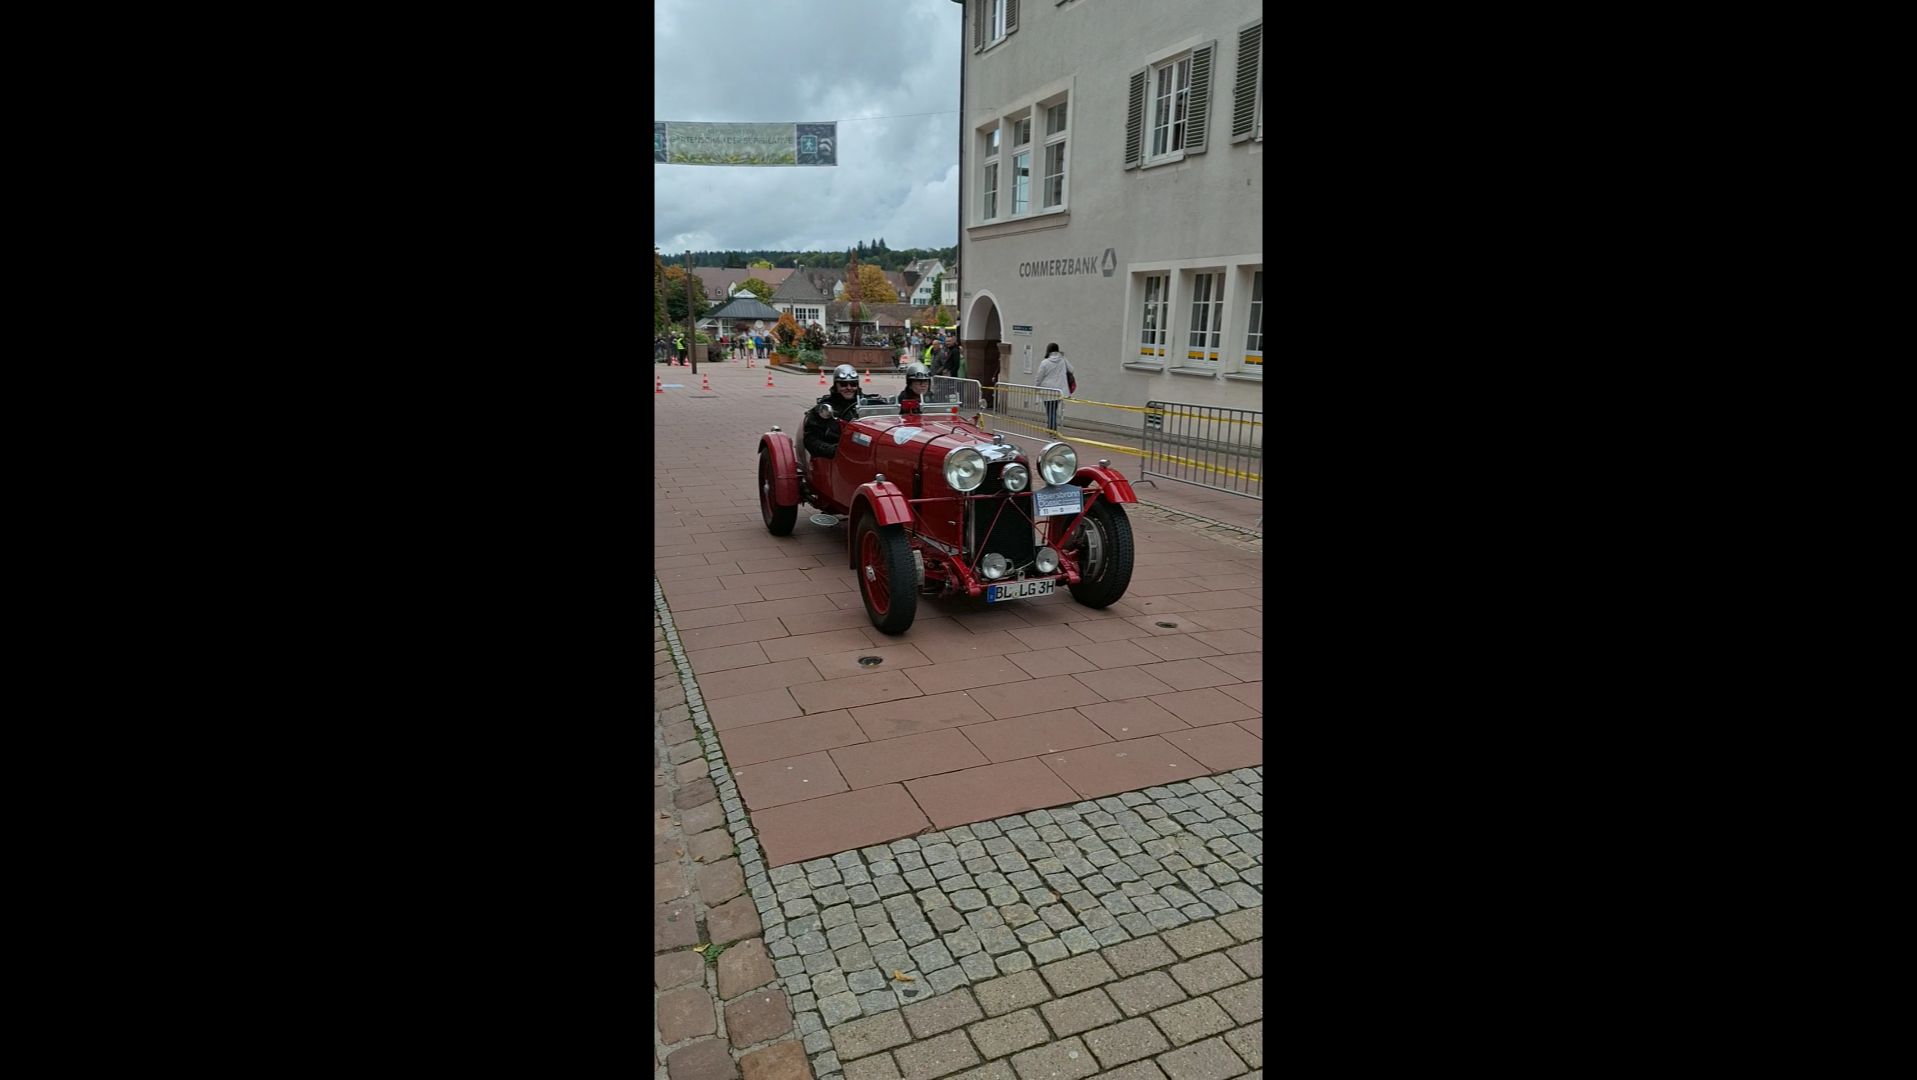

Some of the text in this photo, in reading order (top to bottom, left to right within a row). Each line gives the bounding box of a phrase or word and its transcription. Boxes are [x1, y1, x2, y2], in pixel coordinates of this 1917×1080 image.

[1019, 256, 1098, 277] COMMERZBANK
[996, 581, 1055, 599] BL LG 3H
